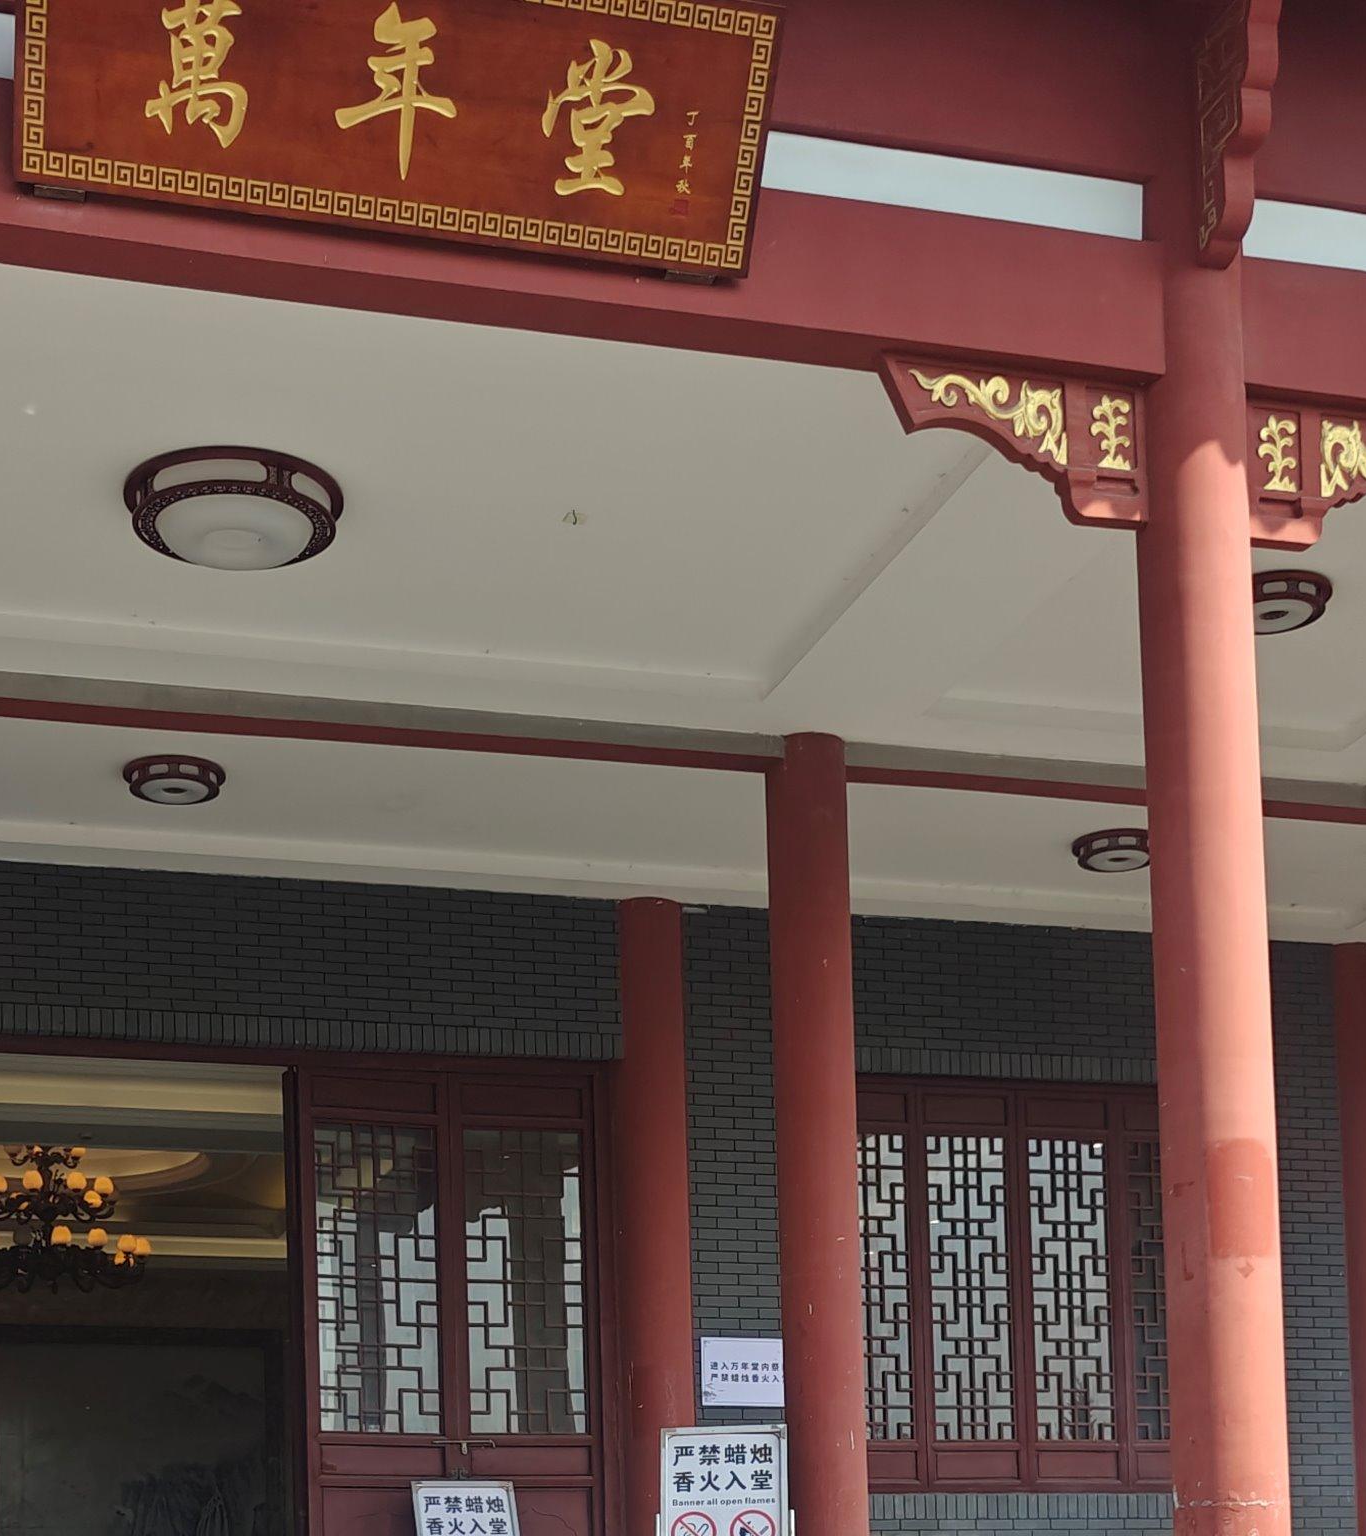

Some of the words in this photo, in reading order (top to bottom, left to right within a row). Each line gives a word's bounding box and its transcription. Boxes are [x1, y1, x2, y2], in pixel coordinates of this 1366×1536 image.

[145, 0, 653, 196] 萬年堂
[710, 1374, 783, 1382] 严禁蜡烛香火入
[673, 1443, 773, 1466] 严禁蜡烛
[673, 1469, 773, 1493] 香火入堂
[423, 1495, 506, 1513] 严禁蜡烛
[426, 1517, 508, 1535] 香火入堂
